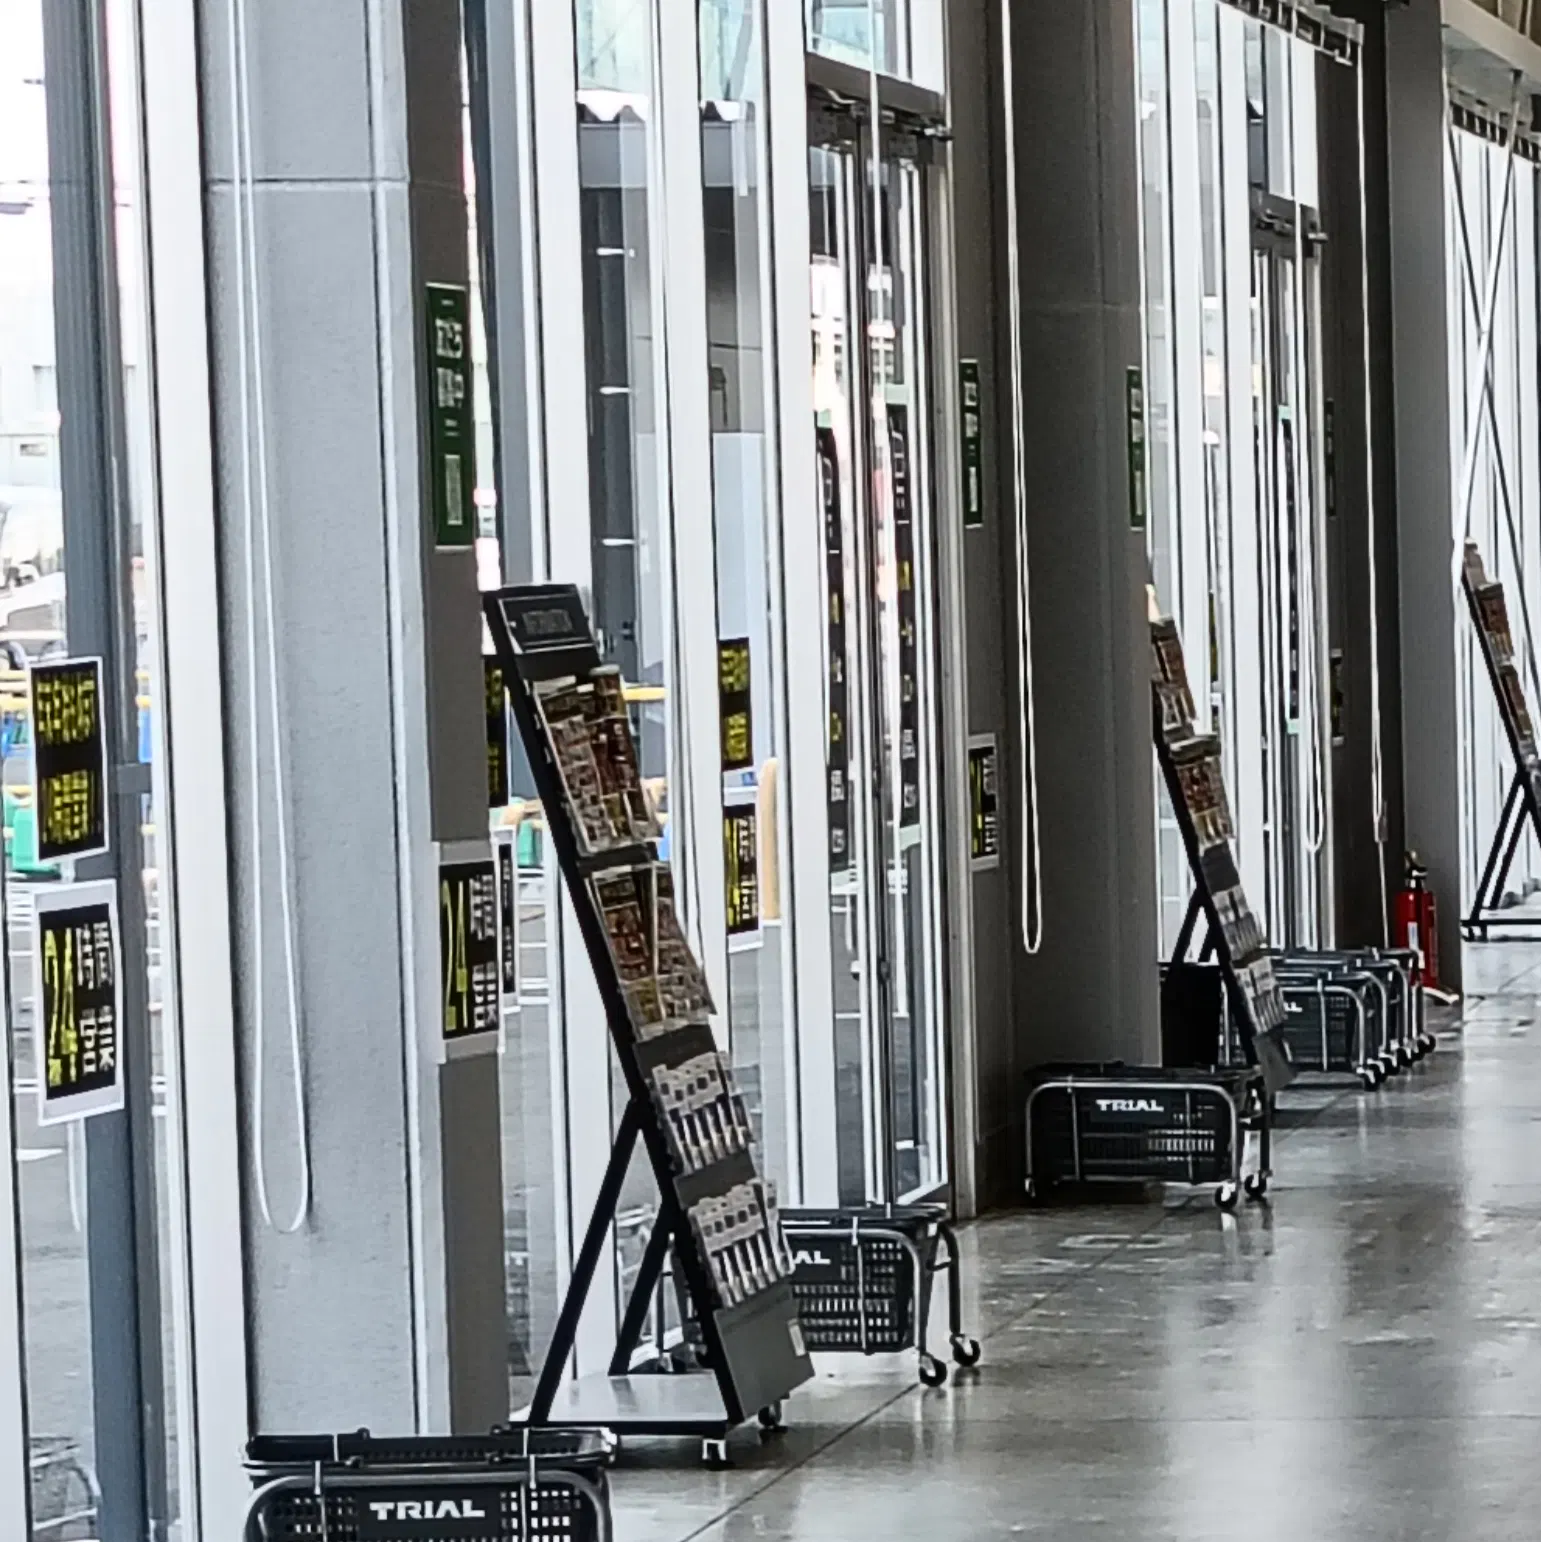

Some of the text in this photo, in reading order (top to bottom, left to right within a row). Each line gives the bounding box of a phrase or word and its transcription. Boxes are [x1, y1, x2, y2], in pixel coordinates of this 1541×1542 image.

[441, 880, 468, 1032] 24
[43, 926, 79, 1088] 24
[1096, 1099, 1165, 1113] TRIAL
[369, 1500, 486, 1522] TRIAL
